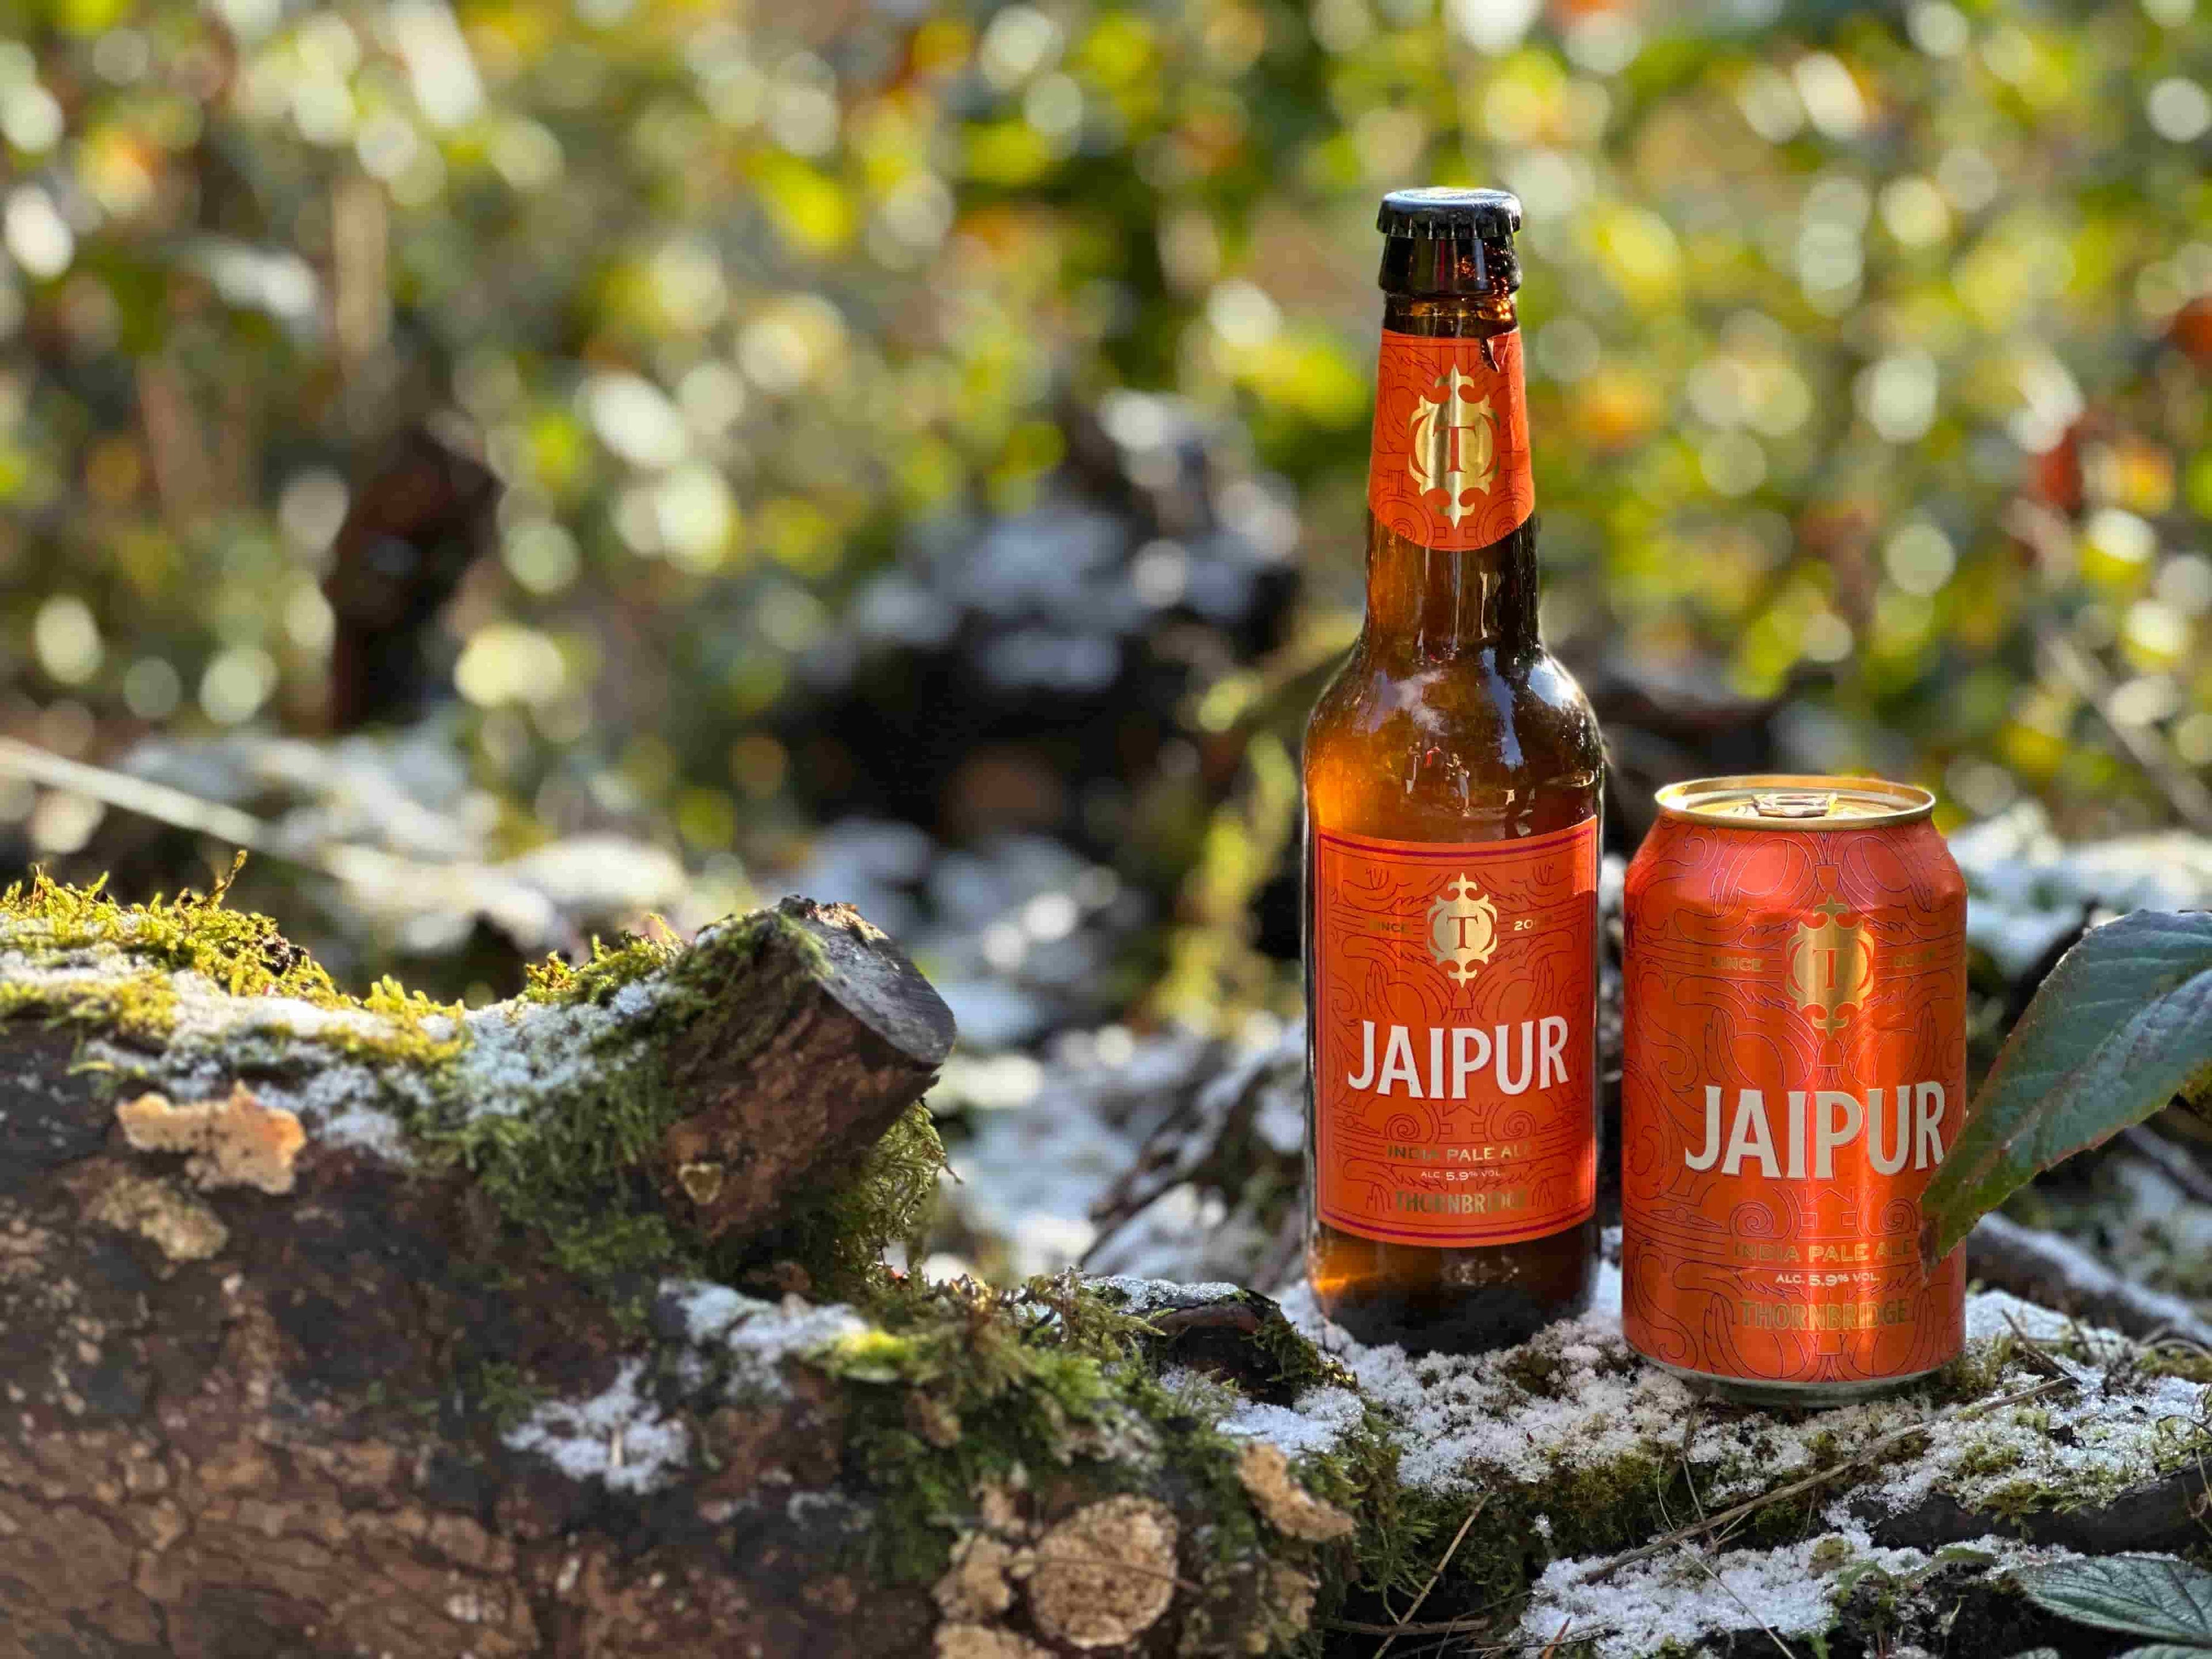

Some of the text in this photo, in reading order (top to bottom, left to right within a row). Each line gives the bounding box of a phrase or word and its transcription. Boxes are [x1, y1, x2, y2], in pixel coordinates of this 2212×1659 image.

[1348, 1016, 1569, 1099] JAIPUR
[1685, 1081, 1945, 1179] JAIPUR
[1446, 1146, 1495, 1163] PALE
[1446, 1171, 1478, 1181] 5.9%
[1734, 1239, 1915, 1263] INDIA PALE ALE
[1775, 1271, 1881, 1287] ALC. 5.9% VOL.
[1738, 1298, 1908, 1331] THORNBRIDGE
